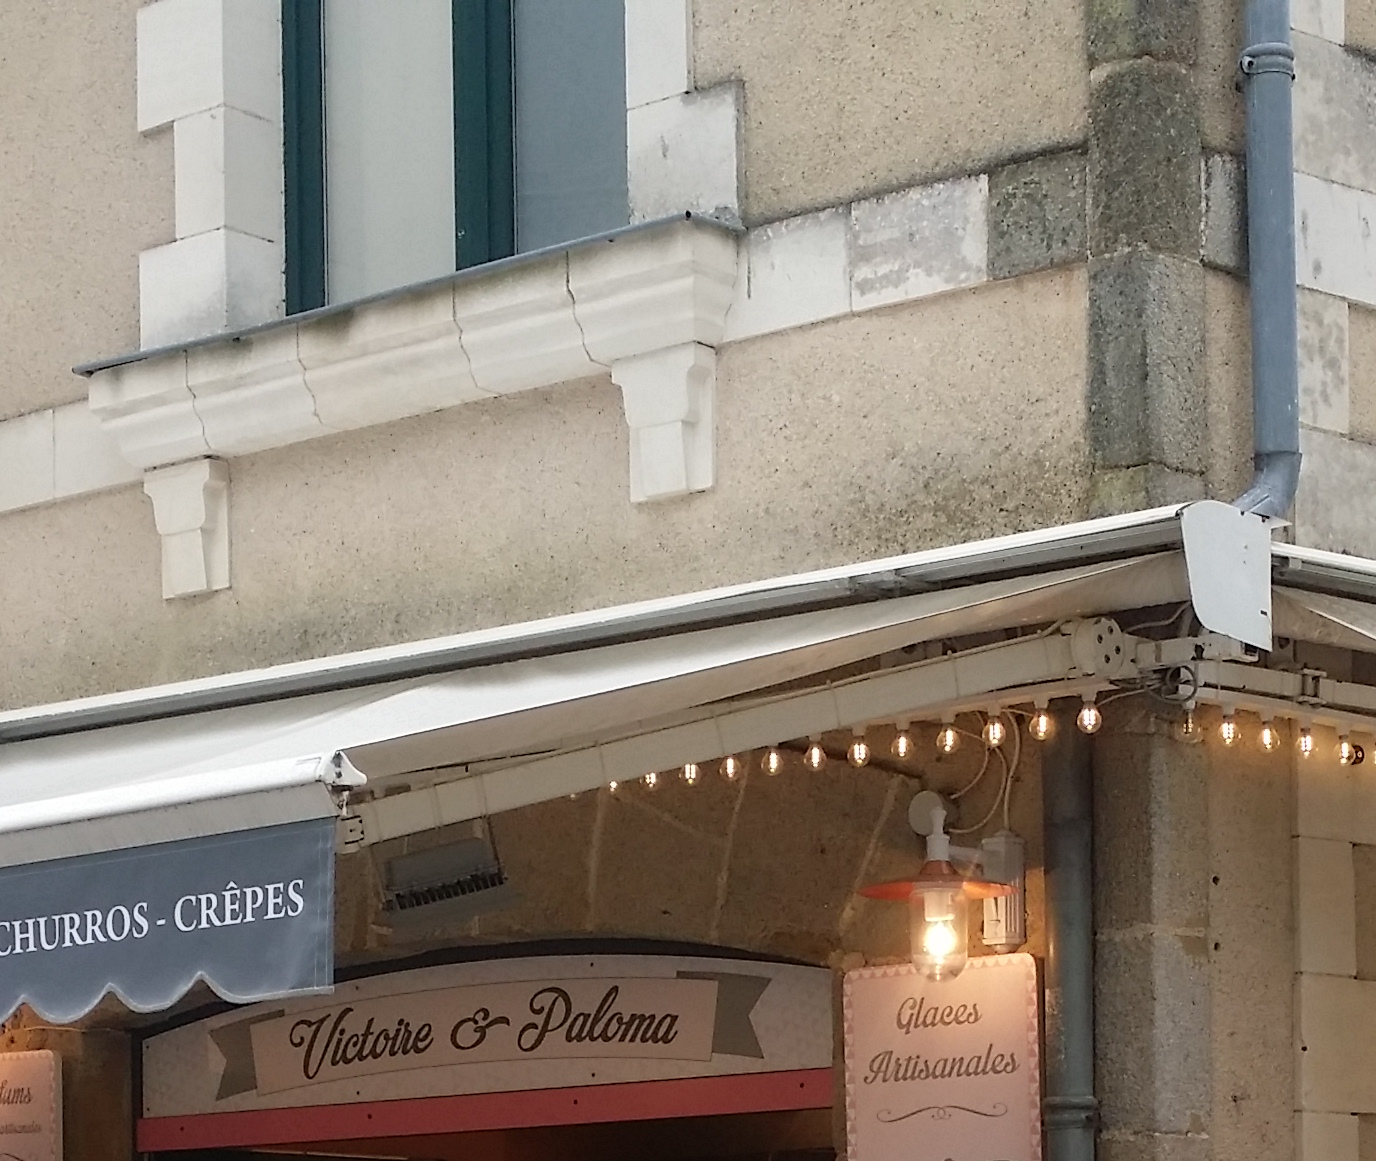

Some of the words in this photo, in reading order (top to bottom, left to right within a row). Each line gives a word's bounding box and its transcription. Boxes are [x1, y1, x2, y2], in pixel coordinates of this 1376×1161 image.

[173, 879, 305, 933] CRÊPES
[289, 1006, 434, 1080] Victoire
[450, 1008, 511, 1051] &
[517, 985, 679, 1053] Paloma
[895, 996, 983, 1035] Glaces
[863, 1043, 1020, 1085] Artisanales
